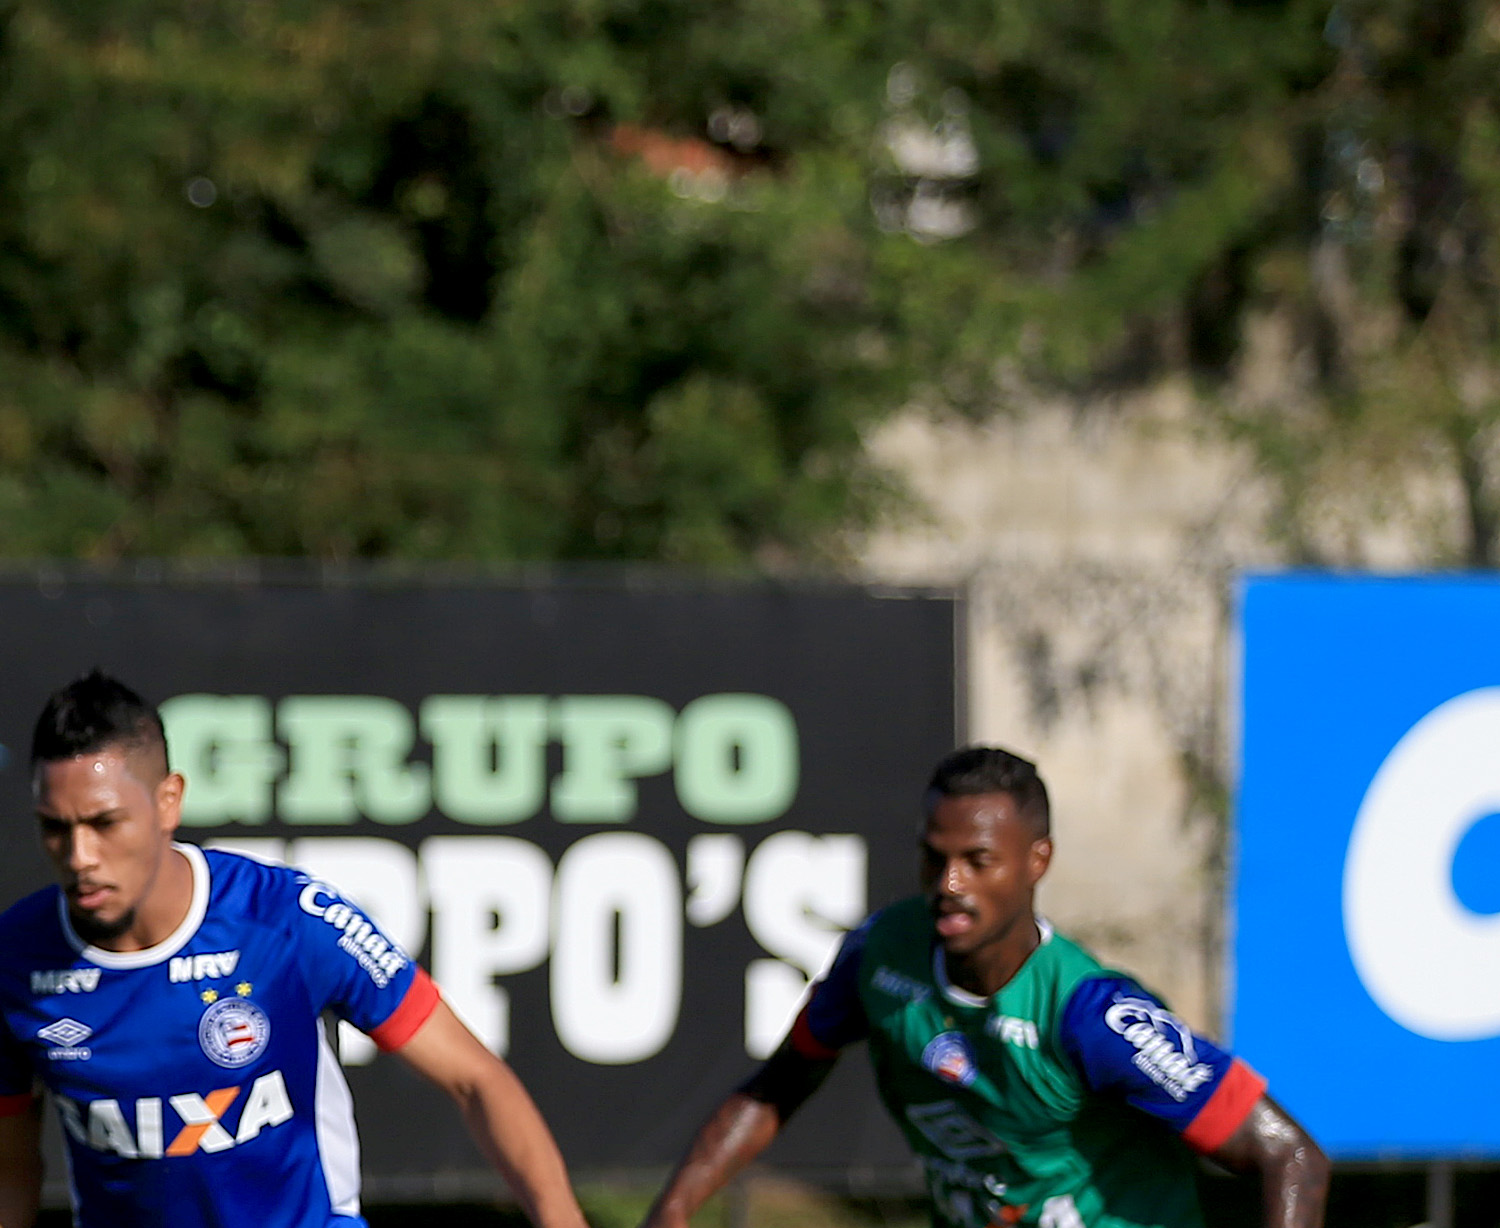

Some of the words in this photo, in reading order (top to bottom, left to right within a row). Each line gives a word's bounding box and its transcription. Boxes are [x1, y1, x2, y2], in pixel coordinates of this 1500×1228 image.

[158, 692, 801, 826] GRUPO
[30, 967, 101, 994] MRV
[169, 950, 240, 983] MRV
